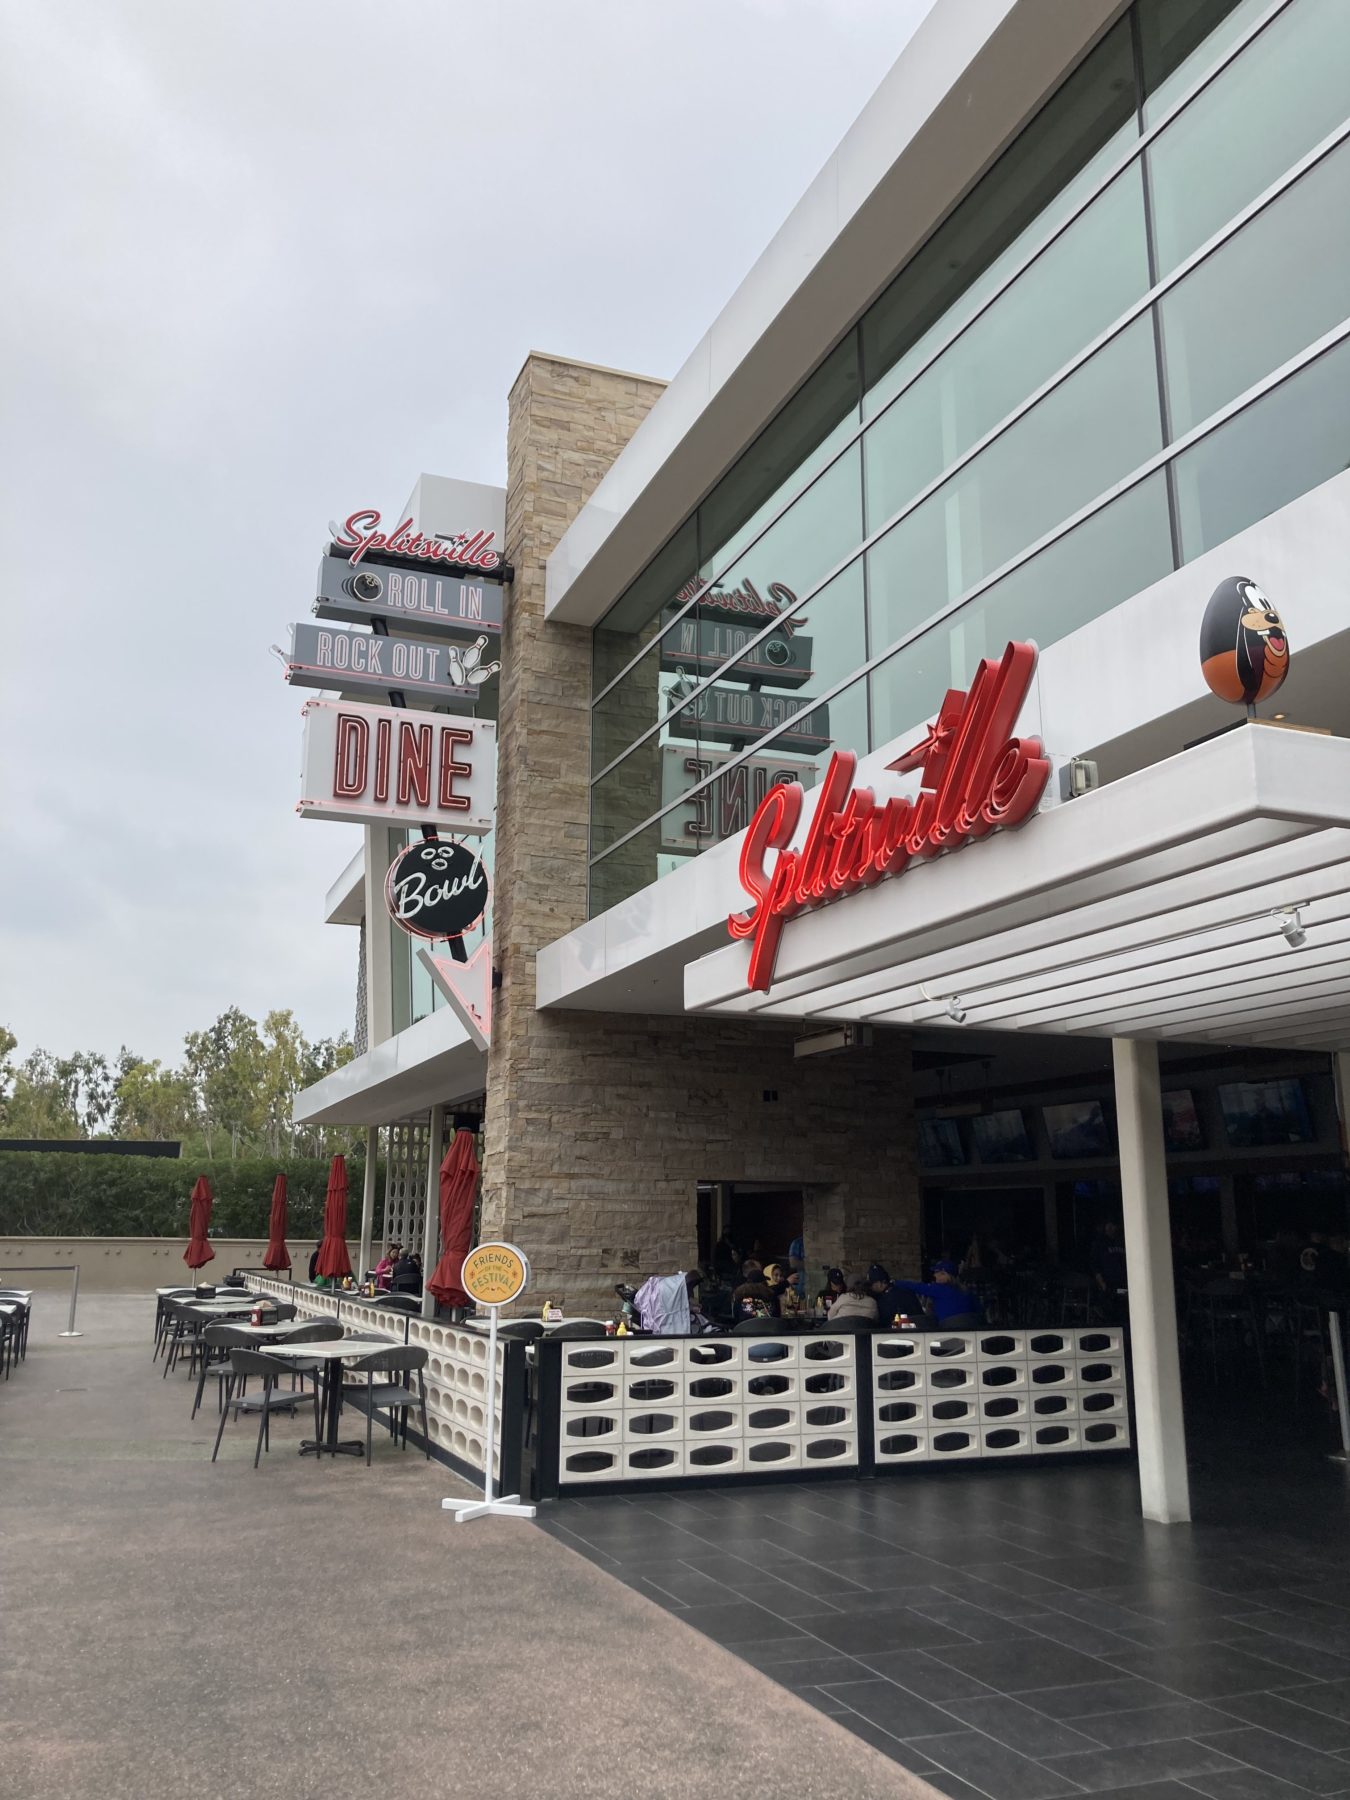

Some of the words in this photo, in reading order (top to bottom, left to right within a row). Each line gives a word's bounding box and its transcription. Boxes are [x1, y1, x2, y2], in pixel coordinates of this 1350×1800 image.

[336, 509, 500, 569] Splitsville
[387, 572, 449, 615] ROLL
[459, 584, 483, 620] IN
[316, 631, 383, 674] ROCK
[392, 643, 440, 682] OUT
[333, 712, 474, 811] DINE
[393, 842, 486, 920] Bowl
[471, 1272, 515, 1291] FESTIVAL
[473, 1253, 514, 1269] FRIENDS
